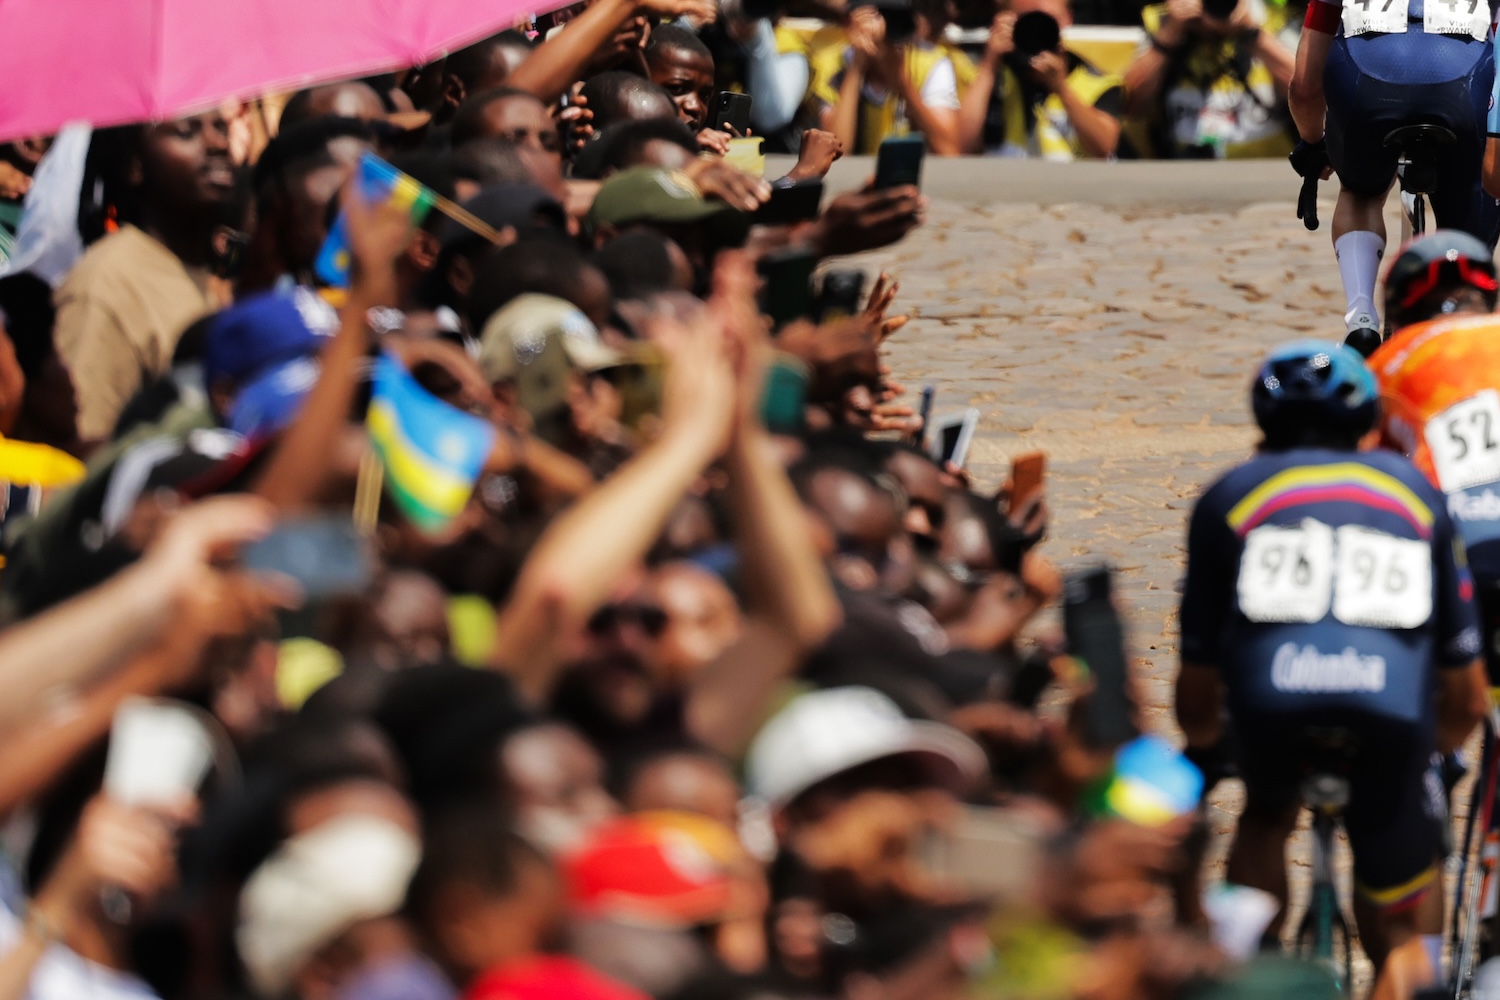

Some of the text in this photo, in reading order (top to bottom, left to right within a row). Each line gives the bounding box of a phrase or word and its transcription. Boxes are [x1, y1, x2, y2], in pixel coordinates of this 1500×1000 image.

[1448, 409, 1498, 461] 52
[1260, 543, 1409, 594] 96 96
